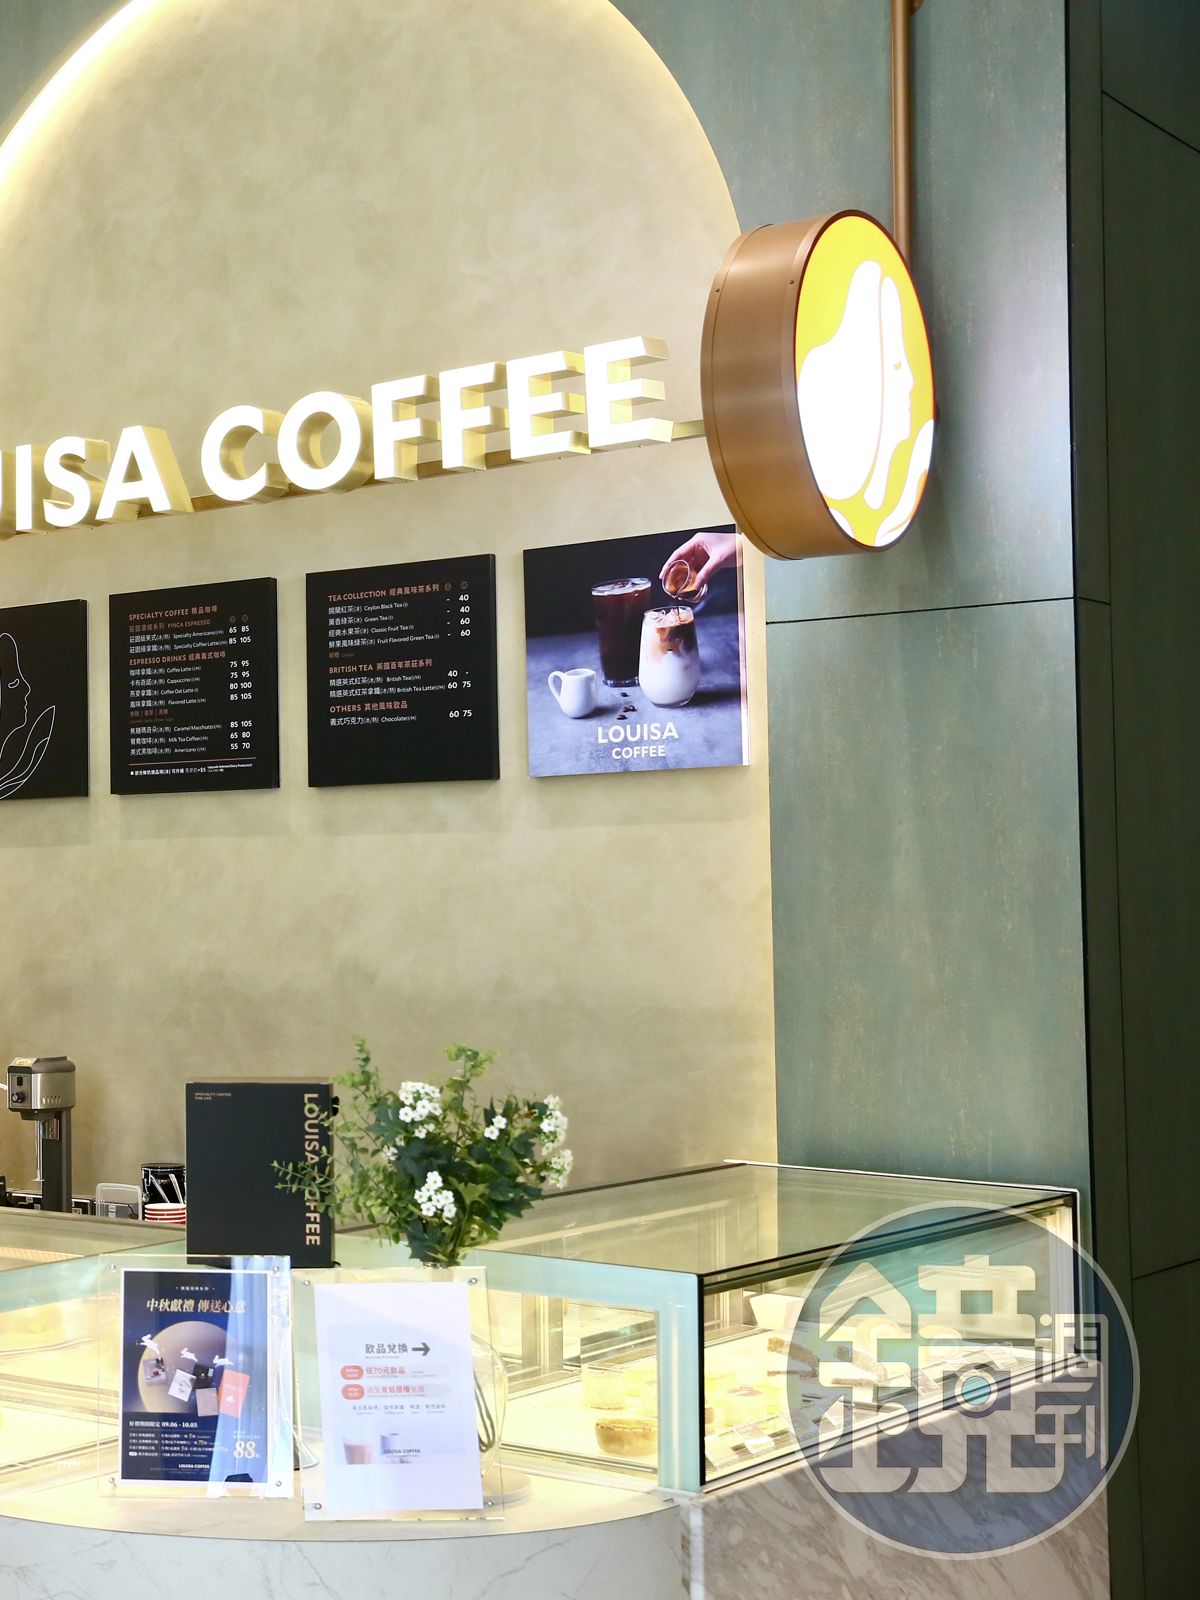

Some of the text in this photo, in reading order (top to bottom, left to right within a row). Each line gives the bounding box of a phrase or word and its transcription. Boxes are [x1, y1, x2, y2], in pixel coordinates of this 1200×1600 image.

[200, 336, 672, 502] COFFEE
[343, 590, 386, 601] COLLECTION
[129, 611, 163, 621] SPECIALTY
[164, 608, 189, 617] COFFEE
[185, 619, 210, 627] ESPRESSO
[460, 617, 470, 625] 60
[229, 626, 237, 634] 65
[460, 629, 471, 637] 60
[129, 656, 160, 666] ESPRESSO
[162, 654, 186, 663] DRINKS
[329, 665, 357, 674] BRITISH
[240, 681, 252, 689] 100
[447, 681, 458, 689] 60
[462, 680, 471, 688] 75
[230, 693, 238, 701] 85
[240, 692, 252, 700] 105
[329, 704, 362, 713] OTHERS
[449, 710, 460, 718] 60
[462, 709, 472, 717] 75
[597, 721, 679, 744] LOUISA
[611, 745, 666, 760] COFFEE
[304, 1093, 320, 1165] LOUISA
[146, 1298, 195, 1313] 中秋獻禮
[364, 1343, 408, 1354] 飲品兌換
[233, 1440, 256, 1459] 88
